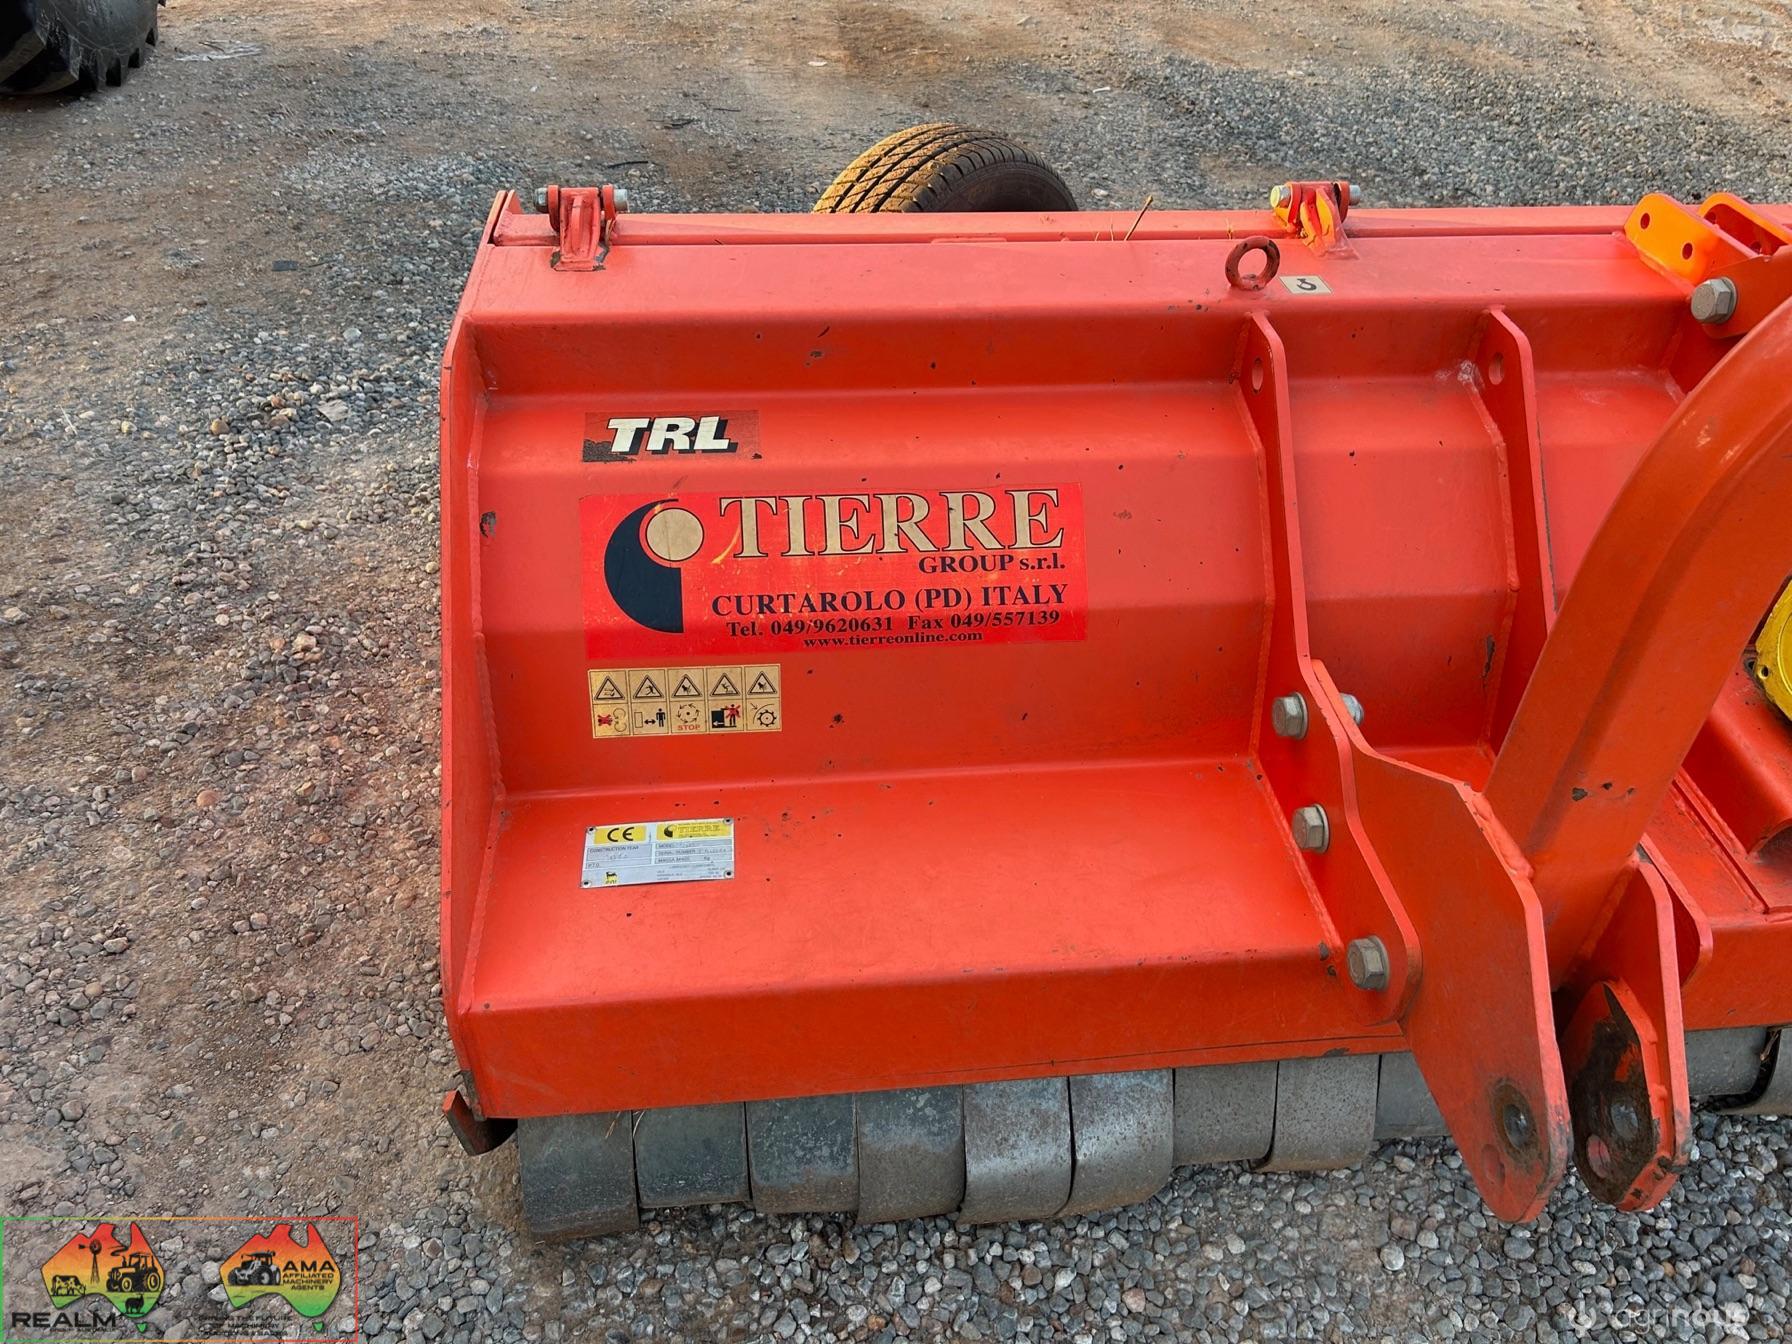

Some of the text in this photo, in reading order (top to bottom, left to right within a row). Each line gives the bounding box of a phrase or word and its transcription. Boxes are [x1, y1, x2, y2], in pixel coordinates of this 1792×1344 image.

[607, 416, 738, 455] TRL
[719, 489, 1065, 559] TIERRE
[918, 553, 1066, 574] GROUP s.r.l.
[711, 584, 1068, 617] CURTAROLO (PD) ITALY
[726, 610, 1060, 637] Tel. 049/9620631 Fax 049/557139
[803, 631, 983, 648] www.tierreonline.com
[607, 827, 635, 843] CE
